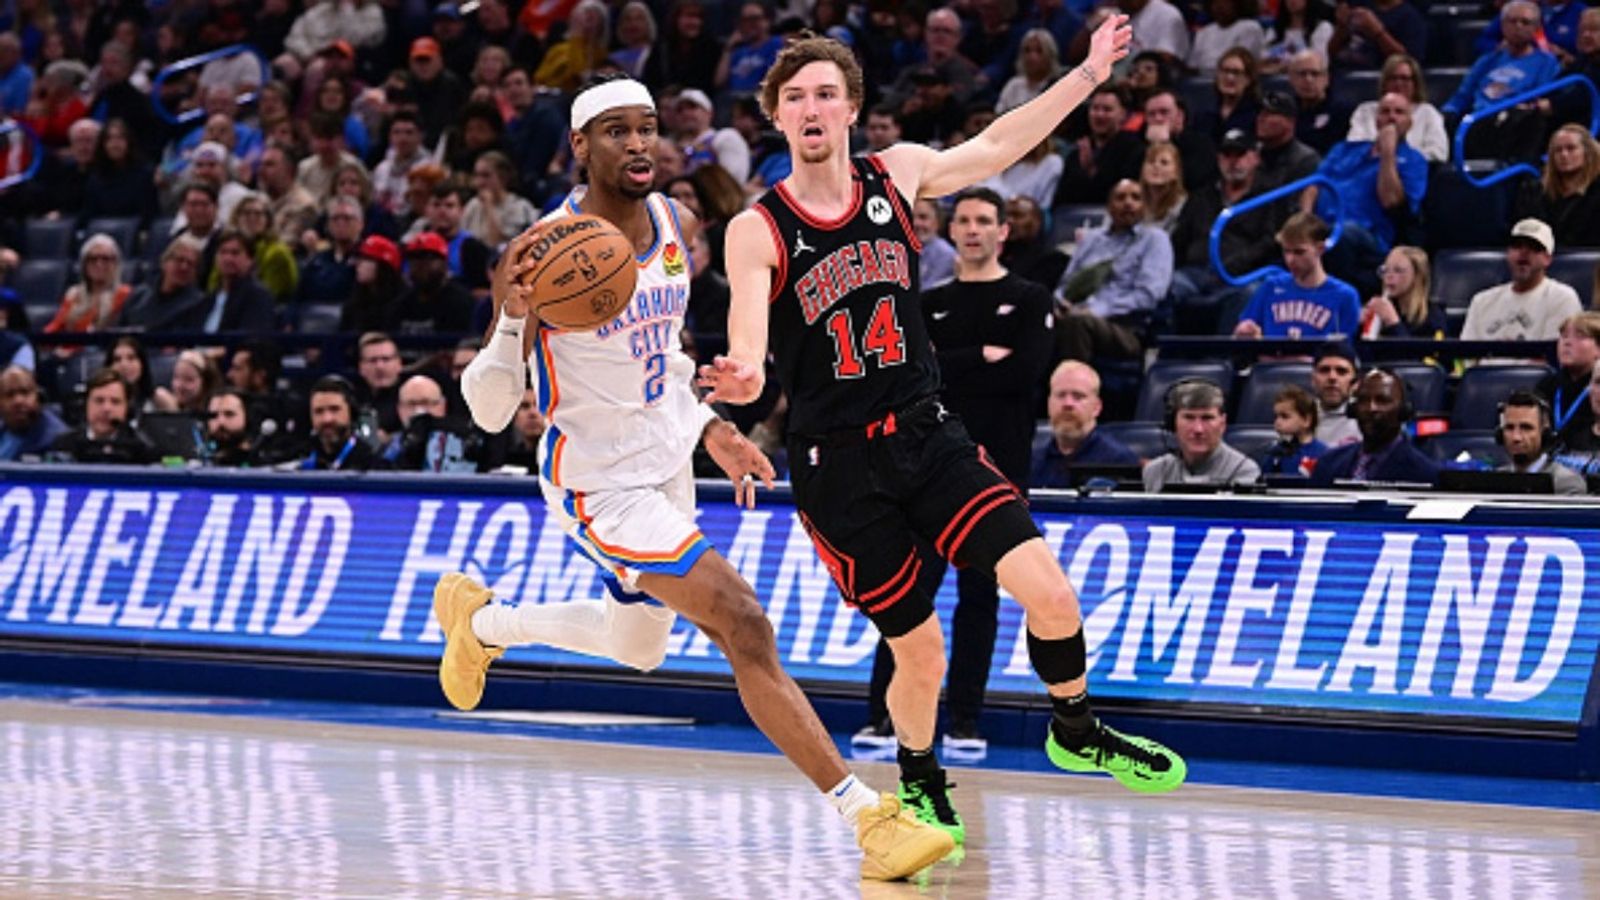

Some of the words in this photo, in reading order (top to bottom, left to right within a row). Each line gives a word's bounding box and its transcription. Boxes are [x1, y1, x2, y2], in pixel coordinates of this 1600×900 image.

[795, 239, 910, 325] CHICAGO
[629, 319, 673, 360] CITY
[827, 295, 907, 379] 14
[644, 352, 667, 407] 2
